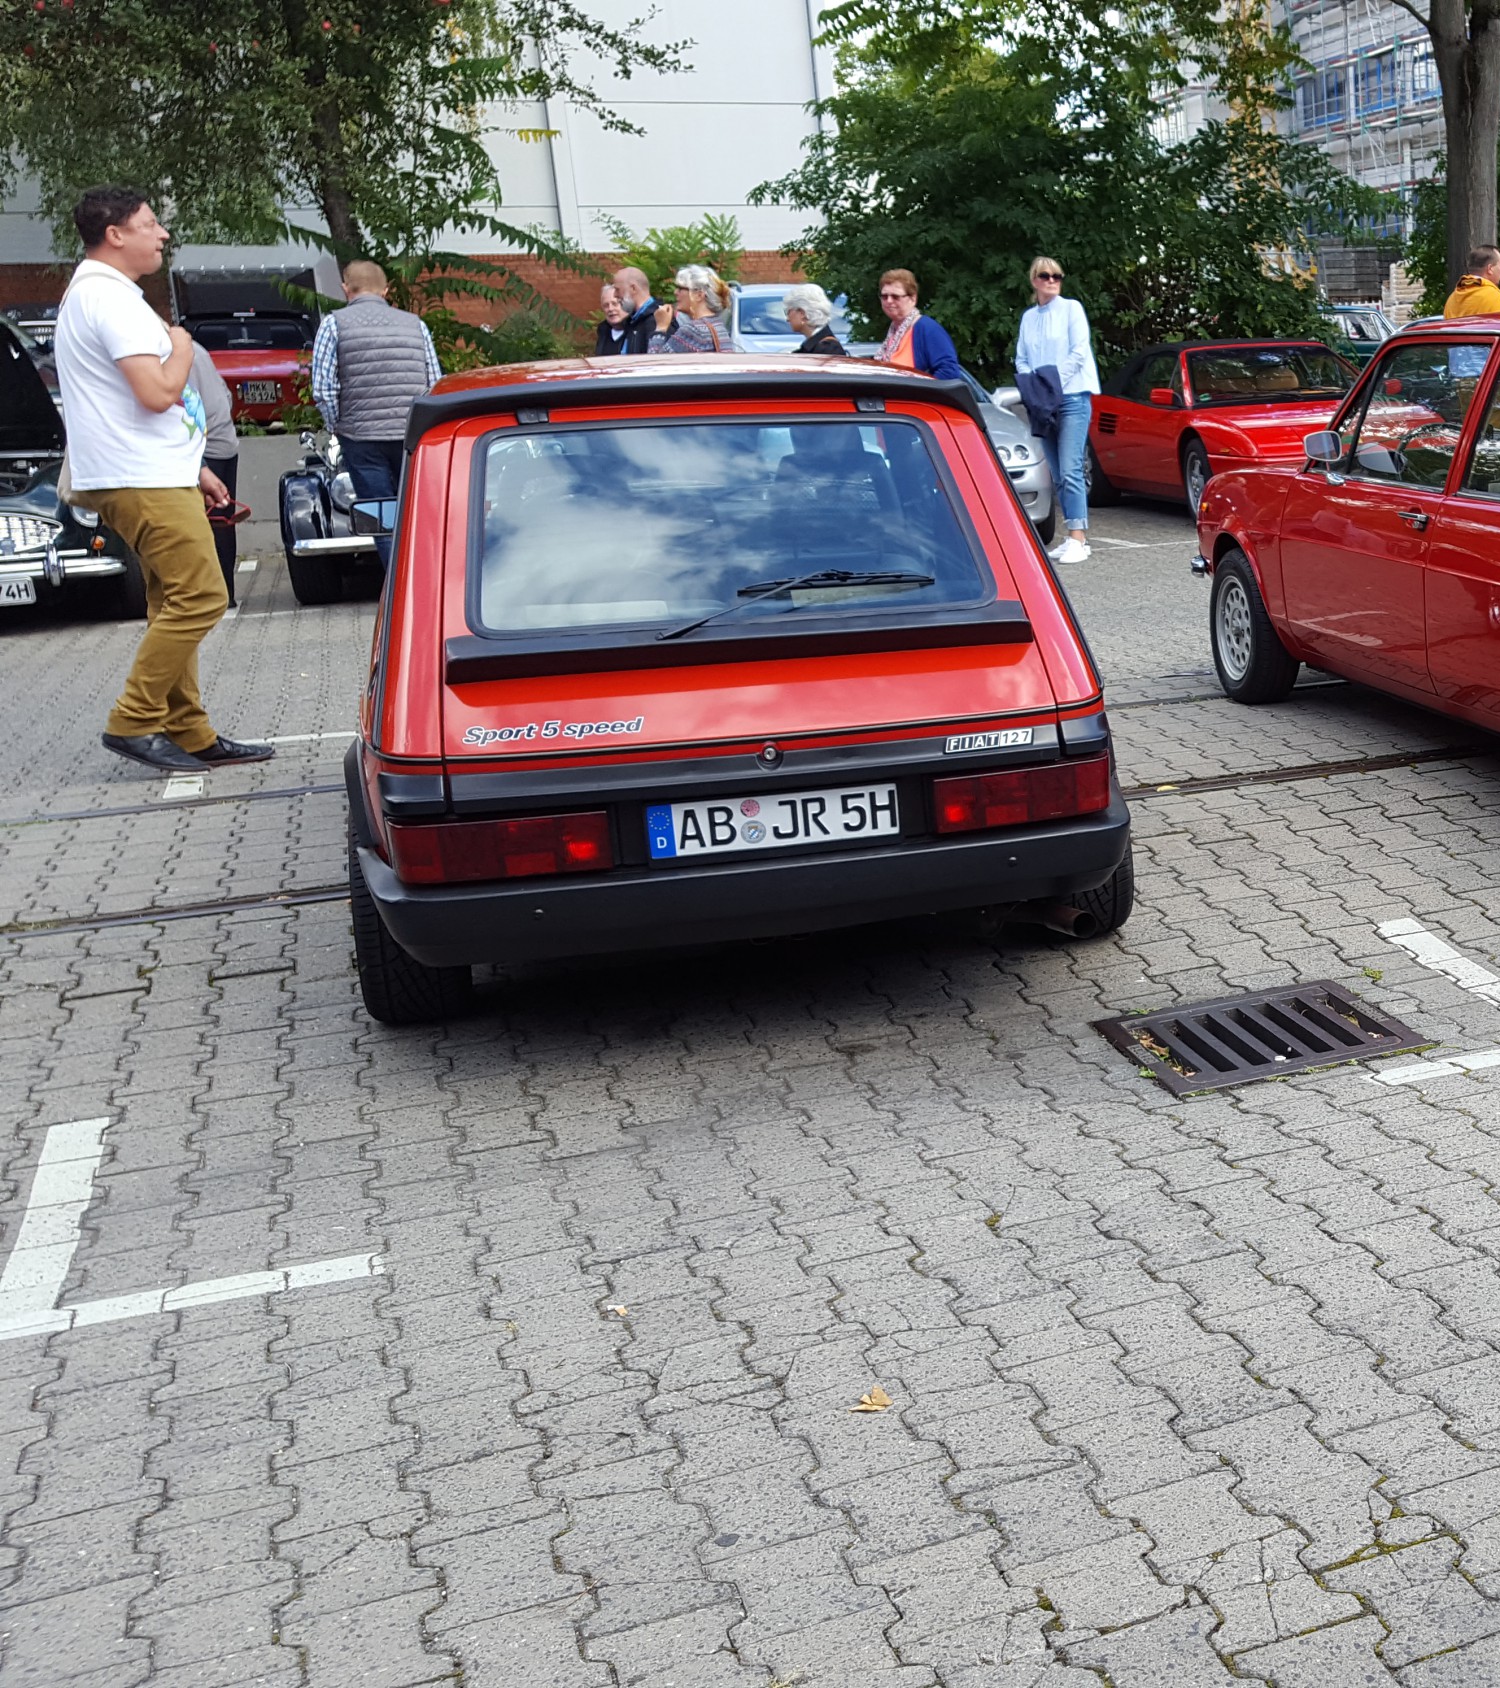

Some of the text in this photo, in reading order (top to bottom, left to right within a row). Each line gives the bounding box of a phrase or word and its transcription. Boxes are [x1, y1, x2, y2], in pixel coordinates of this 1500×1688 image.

[463, 716, 644, 746] Sport 5 speed
[948, 730, 1031, 752] FIAT 127
[679, 787, 899, 850] AB JR 5H
[656, 835, 668, 850] D
